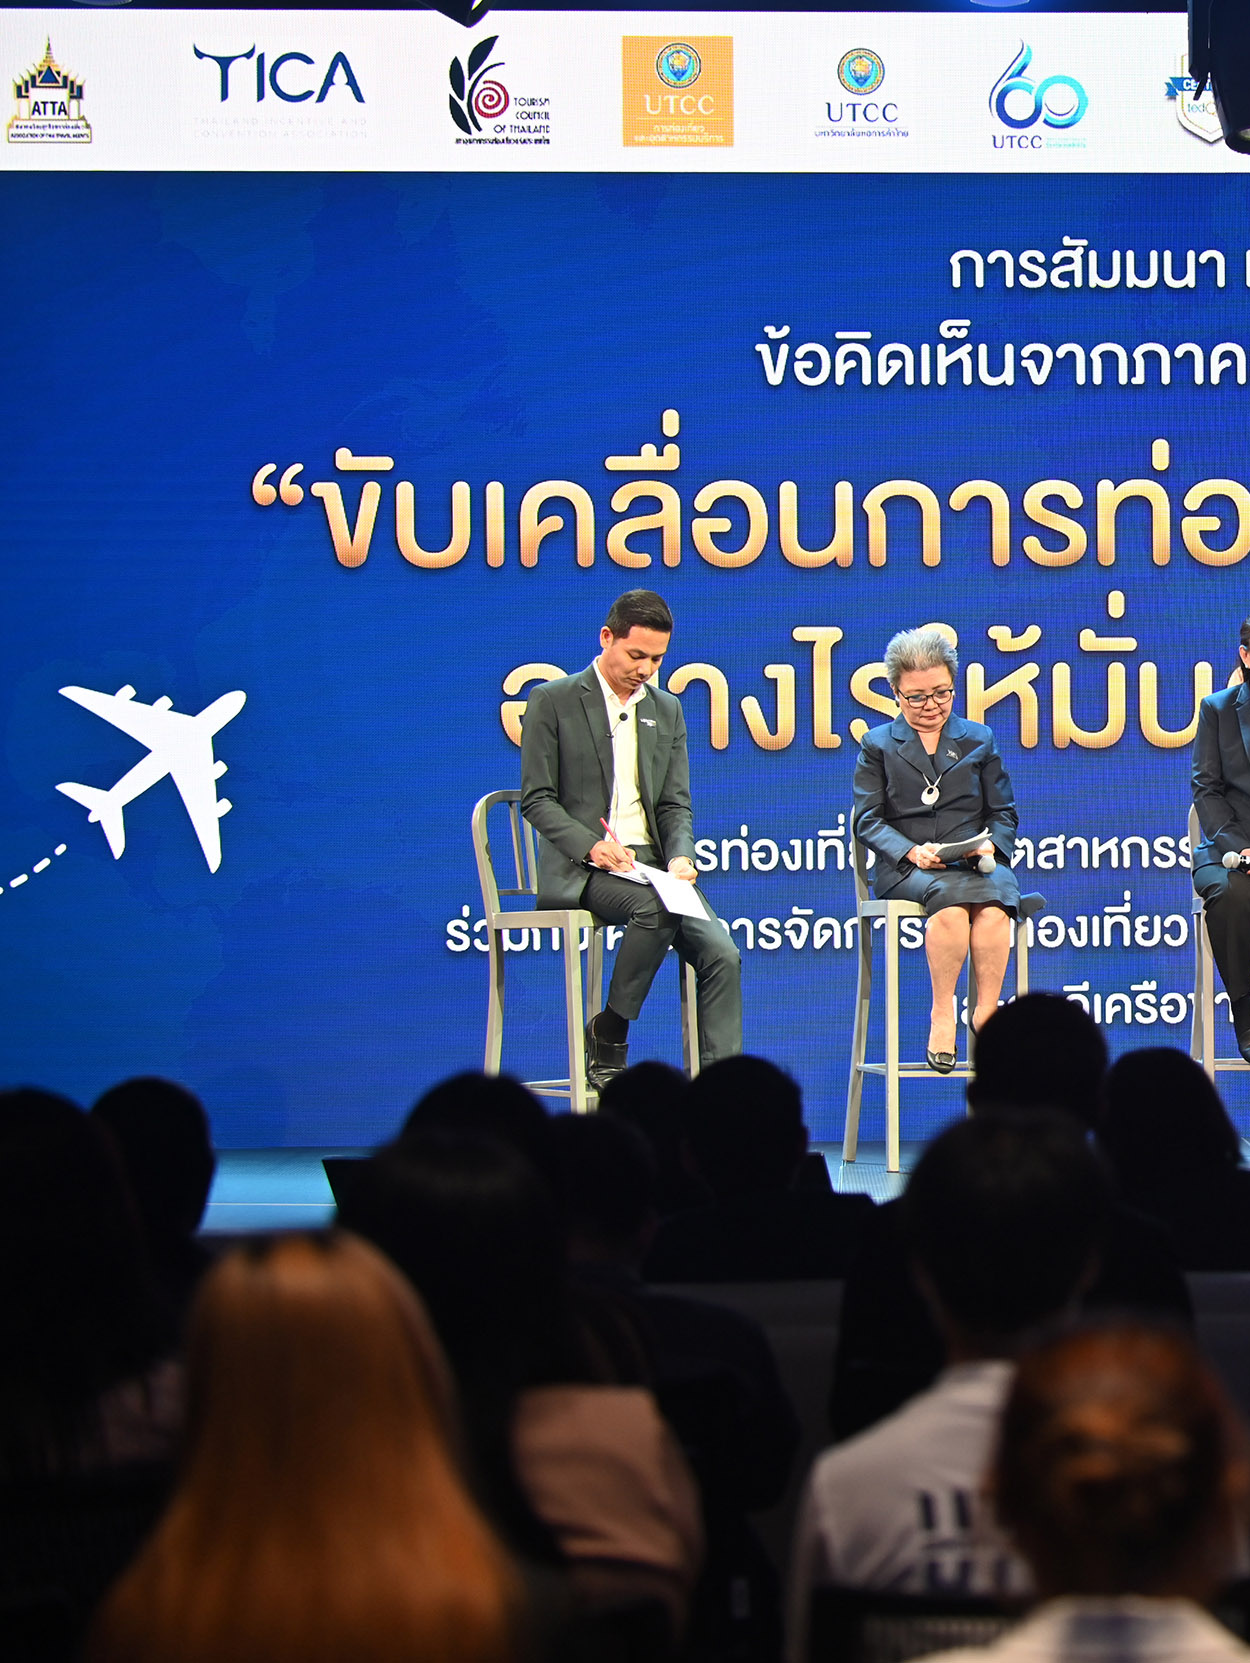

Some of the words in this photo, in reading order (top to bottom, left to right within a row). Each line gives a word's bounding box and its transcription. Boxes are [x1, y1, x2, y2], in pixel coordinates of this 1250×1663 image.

[193, 43, 365, 103] TICA
[32, 101, 68, 116] ATTA
[514, 97, 550, 107] TOURISM
[644, 94, 714, 115] UTCC
[515, 110, 550, 120] COUNCIL
[825, 102, 898, 123] UTCC
[493, 124, 506, 134] OF
[509, 124, 550, 134] THAILAND
[991, 134, 1042, 149] UTCC
[949, 236, 1226, 289] การสัมมนา
